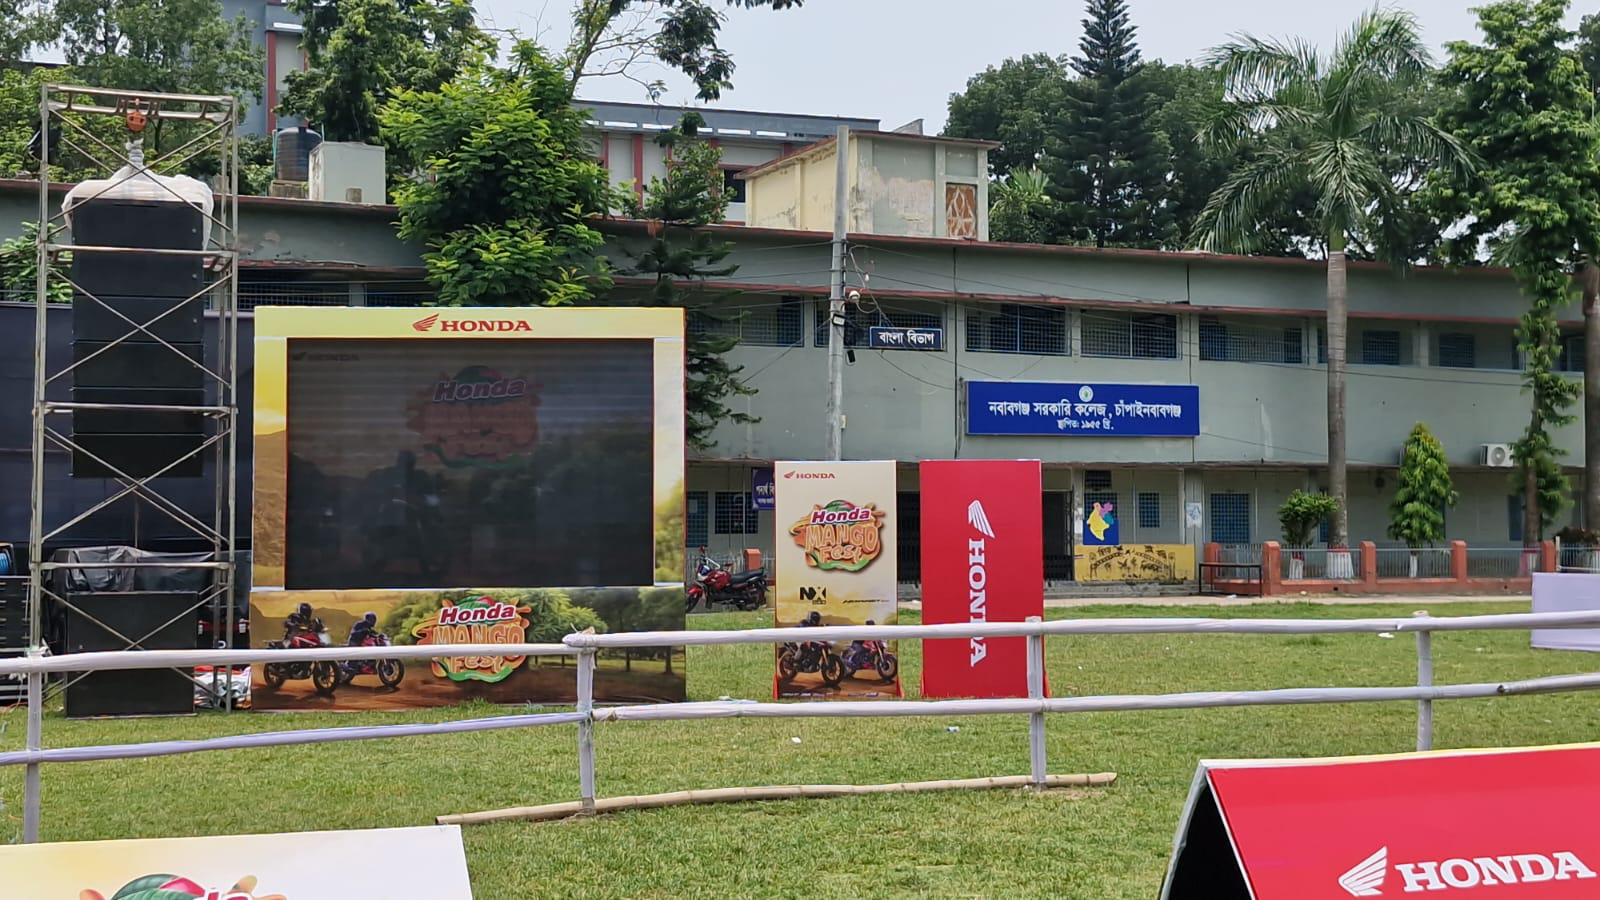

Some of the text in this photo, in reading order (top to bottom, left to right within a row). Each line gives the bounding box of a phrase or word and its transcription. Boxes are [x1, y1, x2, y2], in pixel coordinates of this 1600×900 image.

[440, 320, 533, 332] HONDA
[878, 329, 934, 345] বাংলা বিভাগ
[433, 380, 526, 402] Honda
[988, 401, 1030, 416] নবাবগঞ্জ
[1033, 399, 1071, 417] সরকারি
[1114, 399, 1182, 418] চাঁপাইনবাবগঞ্জ
[811, 507, 871, 524] Honda
[805, 523, 879, 552] MANGO
[820, 545, 862, 564] Fest
[439, 603, 516, 625] Honda
[1394, 851, 1598, 893] HONDA
